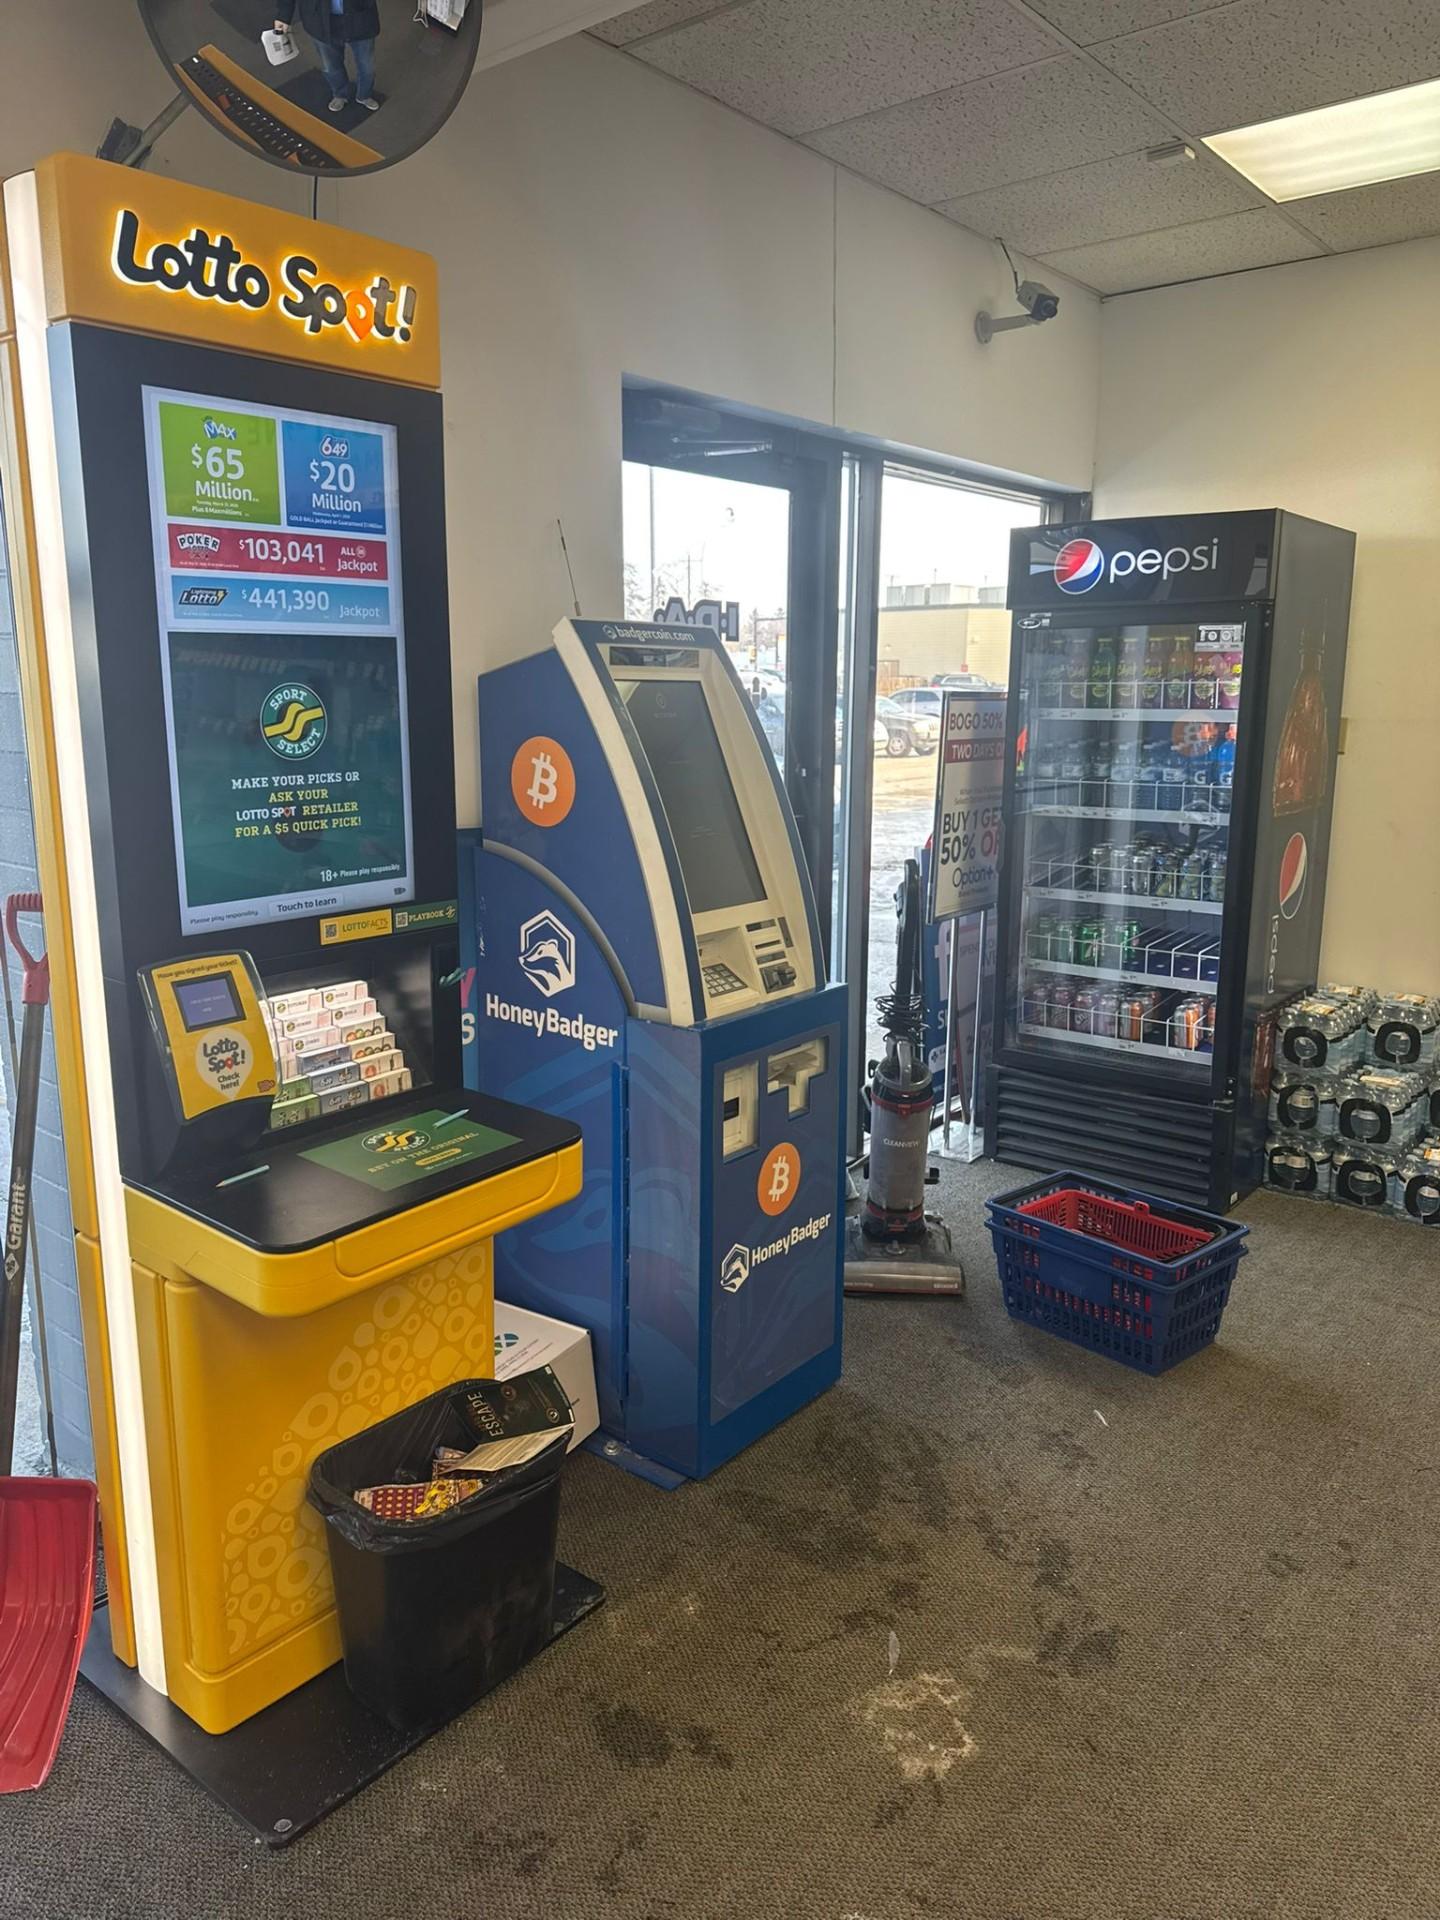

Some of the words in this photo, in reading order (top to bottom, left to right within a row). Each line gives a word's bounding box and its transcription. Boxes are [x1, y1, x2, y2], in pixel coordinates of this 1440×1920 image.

[112, 210, 270, 309] Lotto
[281, 255, 417, 343] Spot!
[204, 420, 236, 440] MAX
[322, 437, 348, 457] 649
[191, 443, 245, 480] $65
[310, 459, 356, 493] $20
[195, 480, 252, 502] Million
[312, 493, 362, 513] Million
[179, 536, 219, 551] POKER
[239, 538, 324, 566] $103,041
[341, 547, 355, 556] ALL
[337, 559, 378, 574] Jackpot
[1110, 538, 1219, 583] pepsi
[181, 591, 217, 604] Lotto
[242, 587, 330, 613] $441,390
[339, 605, 381, 620] Jackpot
[615, 625, 696, 642] badgercoin.com
[269, 688, 307, 711] SPORT
[950, 712, 981, 730] BOGO
[277, 728, 321, 754] SELECT
[952, 743, 972, 760] TWO
[232, 776, 269, 790] MAKE
[272, 774, 306, 788] YOUR
[307, 771, 342, 785] PICKS
[345, 771, 361, 782] OR
[268, 792, 294, 804] ASK
[297, 789, 329, 800] YOUR
[236, 808, 269, 821] LOTTO
[271, 806, 297, 819] SPOT
[302, 801, 359, 818] RETAILER
[943, 810, 970, 834] BUY
[981, 807, 1001, 828] GE
[235, 825, 260, 838] FOR
[262, 824, 271, 835] A
[275, 821, 289, 834] $5
[292, 820, 329, 833] QUICK
[331, 816, 362, 828] PICK!
[941, 832, 976, 865] 50%
[320, 869, 339, 883] 18+
[339, 869, 358, 878] Please
[358, 866, 371, 876] play
[953, 865, 994, 890] Option+
[277, 900, 304, 913] Touch
[305, 899, 314, 909] to
[315, 897, 337, 906] learn
[211, 914, 225, 923] play
[408, 910, 444, 923] PLAYBOOK
[1267, 914, 1280, 995] pepsi
[486, 992, 619, 1051] HoneyBadger
[203, 1038, 239, 1057] Lotto
[208, 1049, 245, 1073] Spot!
[217, 1072, 240, 1083] Check
[221, 1080, 240, 1090] here!
[7, 1181, 25, 1250] Garant
[751, 1213, 831, 1267] HoneyBadger
[467, 1391, 504, 1437] ESCAPE
